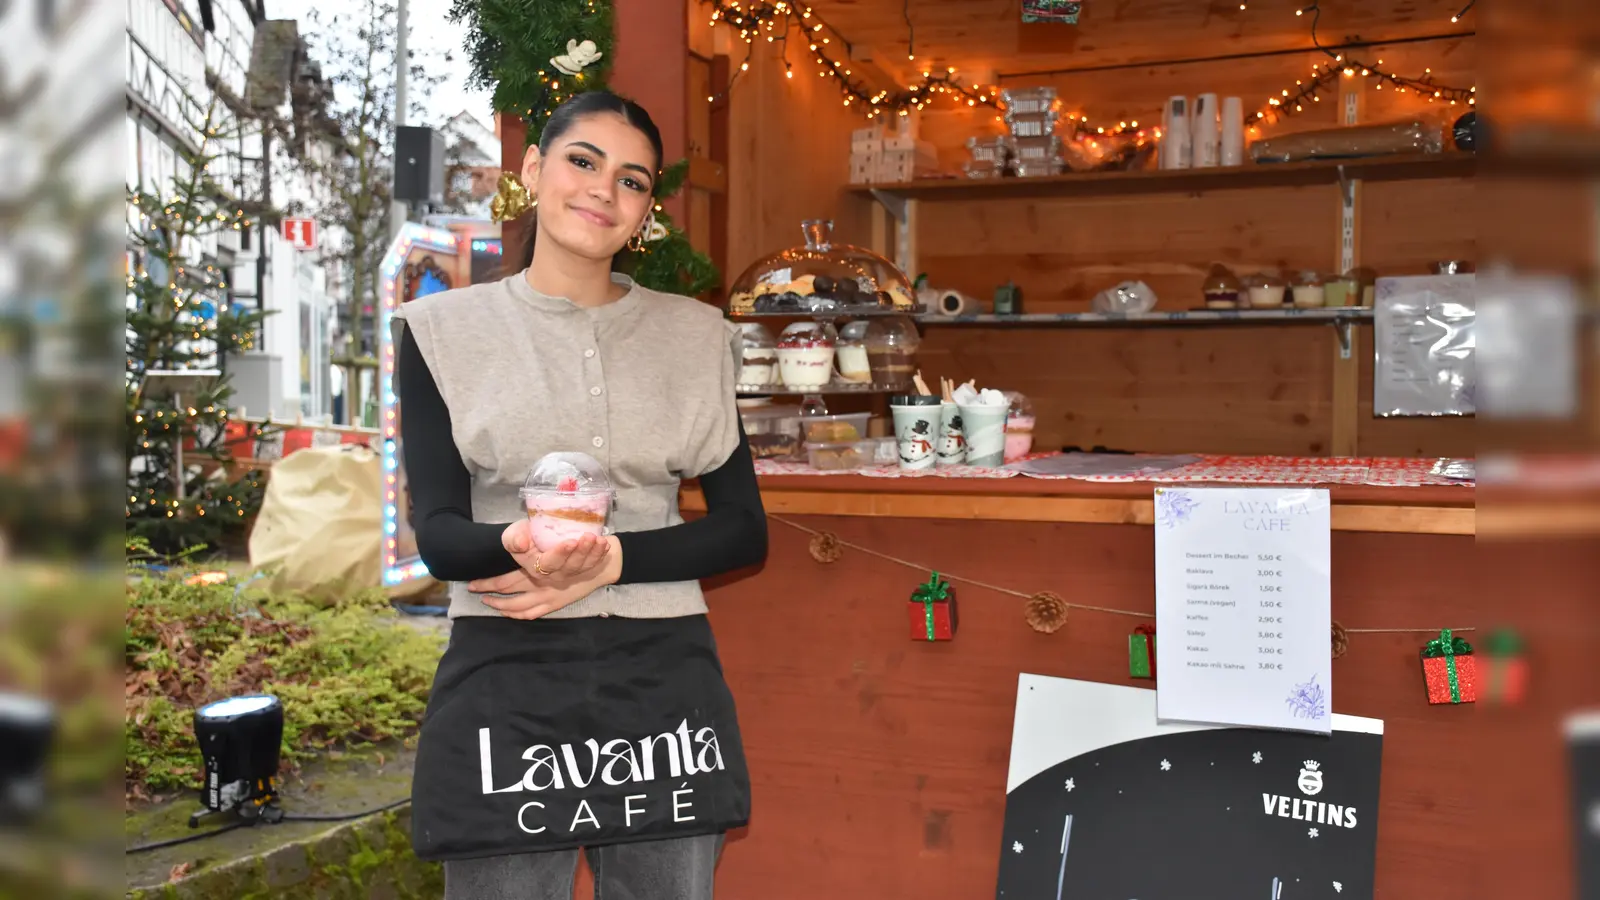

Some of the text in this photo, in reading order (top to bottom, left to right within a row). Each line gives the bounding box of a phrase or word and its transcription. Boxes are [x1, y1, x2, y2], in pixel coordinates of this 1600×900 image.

[479, 718, 725, 794] Lavanta
[517, 782, 696, 834] CAFÉ
[1262, 793, 1357, 828] VELTINS
